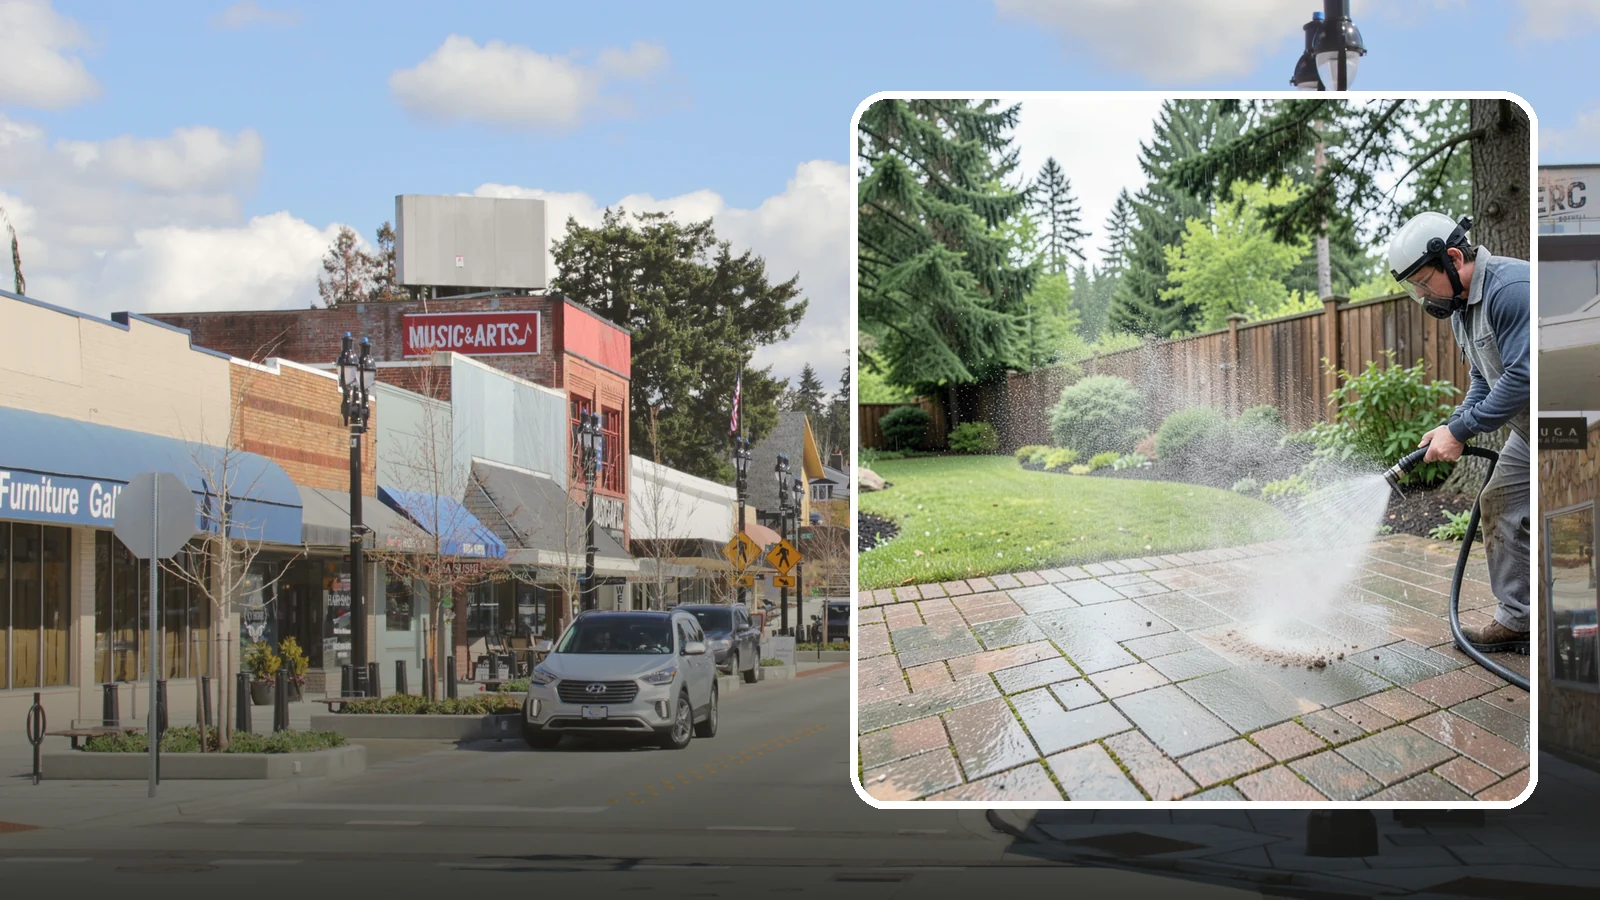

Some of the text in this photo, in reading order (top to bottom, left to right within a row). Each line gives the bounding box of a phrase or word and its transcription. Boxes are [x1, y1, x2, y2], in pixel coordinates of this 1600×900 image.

[1541, 428, 1577, 437] UGA
[0, 471, 122, 519] Furniture Gal
